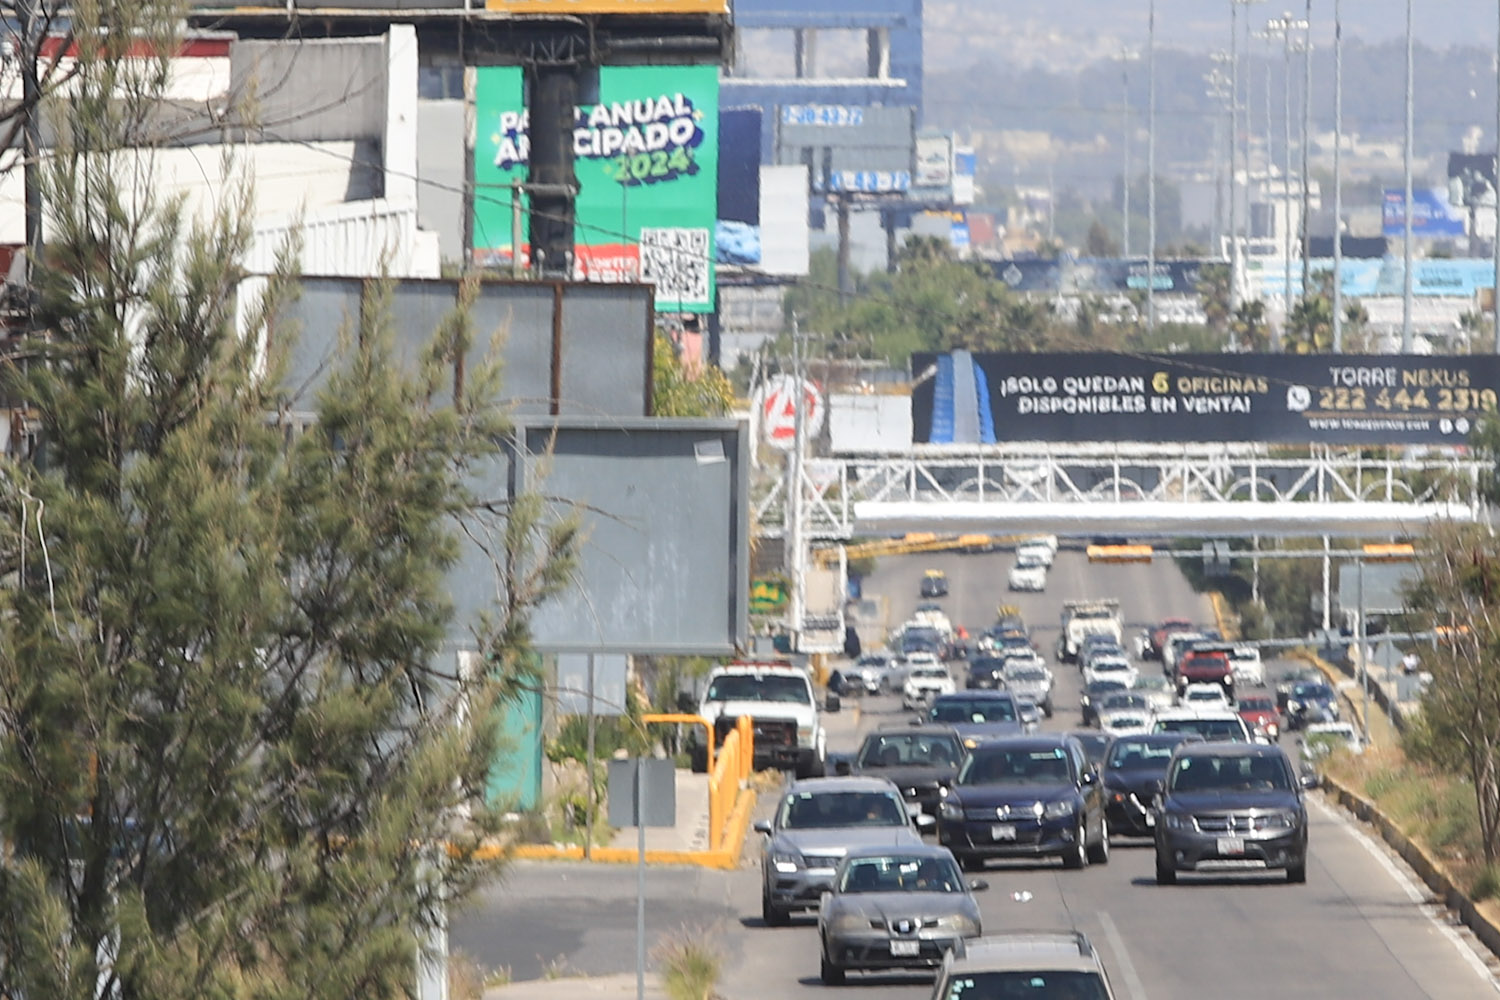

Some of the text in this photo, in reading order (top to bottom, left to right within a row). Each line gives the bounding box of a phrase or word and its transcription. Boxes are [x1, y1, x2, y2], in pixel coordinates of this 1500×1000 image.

[589, 92, 692, 127] ANUAL
[613, 145, 693, 181] 2024
[1062, 375, 1145, 394] QUEDAN
[1151, 371, 1170, 394] 6
[1177, 375, 1269, 394] OFICINAS
[1329, 366, 1470, 387] TORRE NEXUS
[1018, 395, 1251, 414] DISPONIBLES EN VENTA!
[1319, 387, 1367, 410] 222
[1374, 387, 1431, 411] 444
[1436, 387, 1498, 411] 2319
